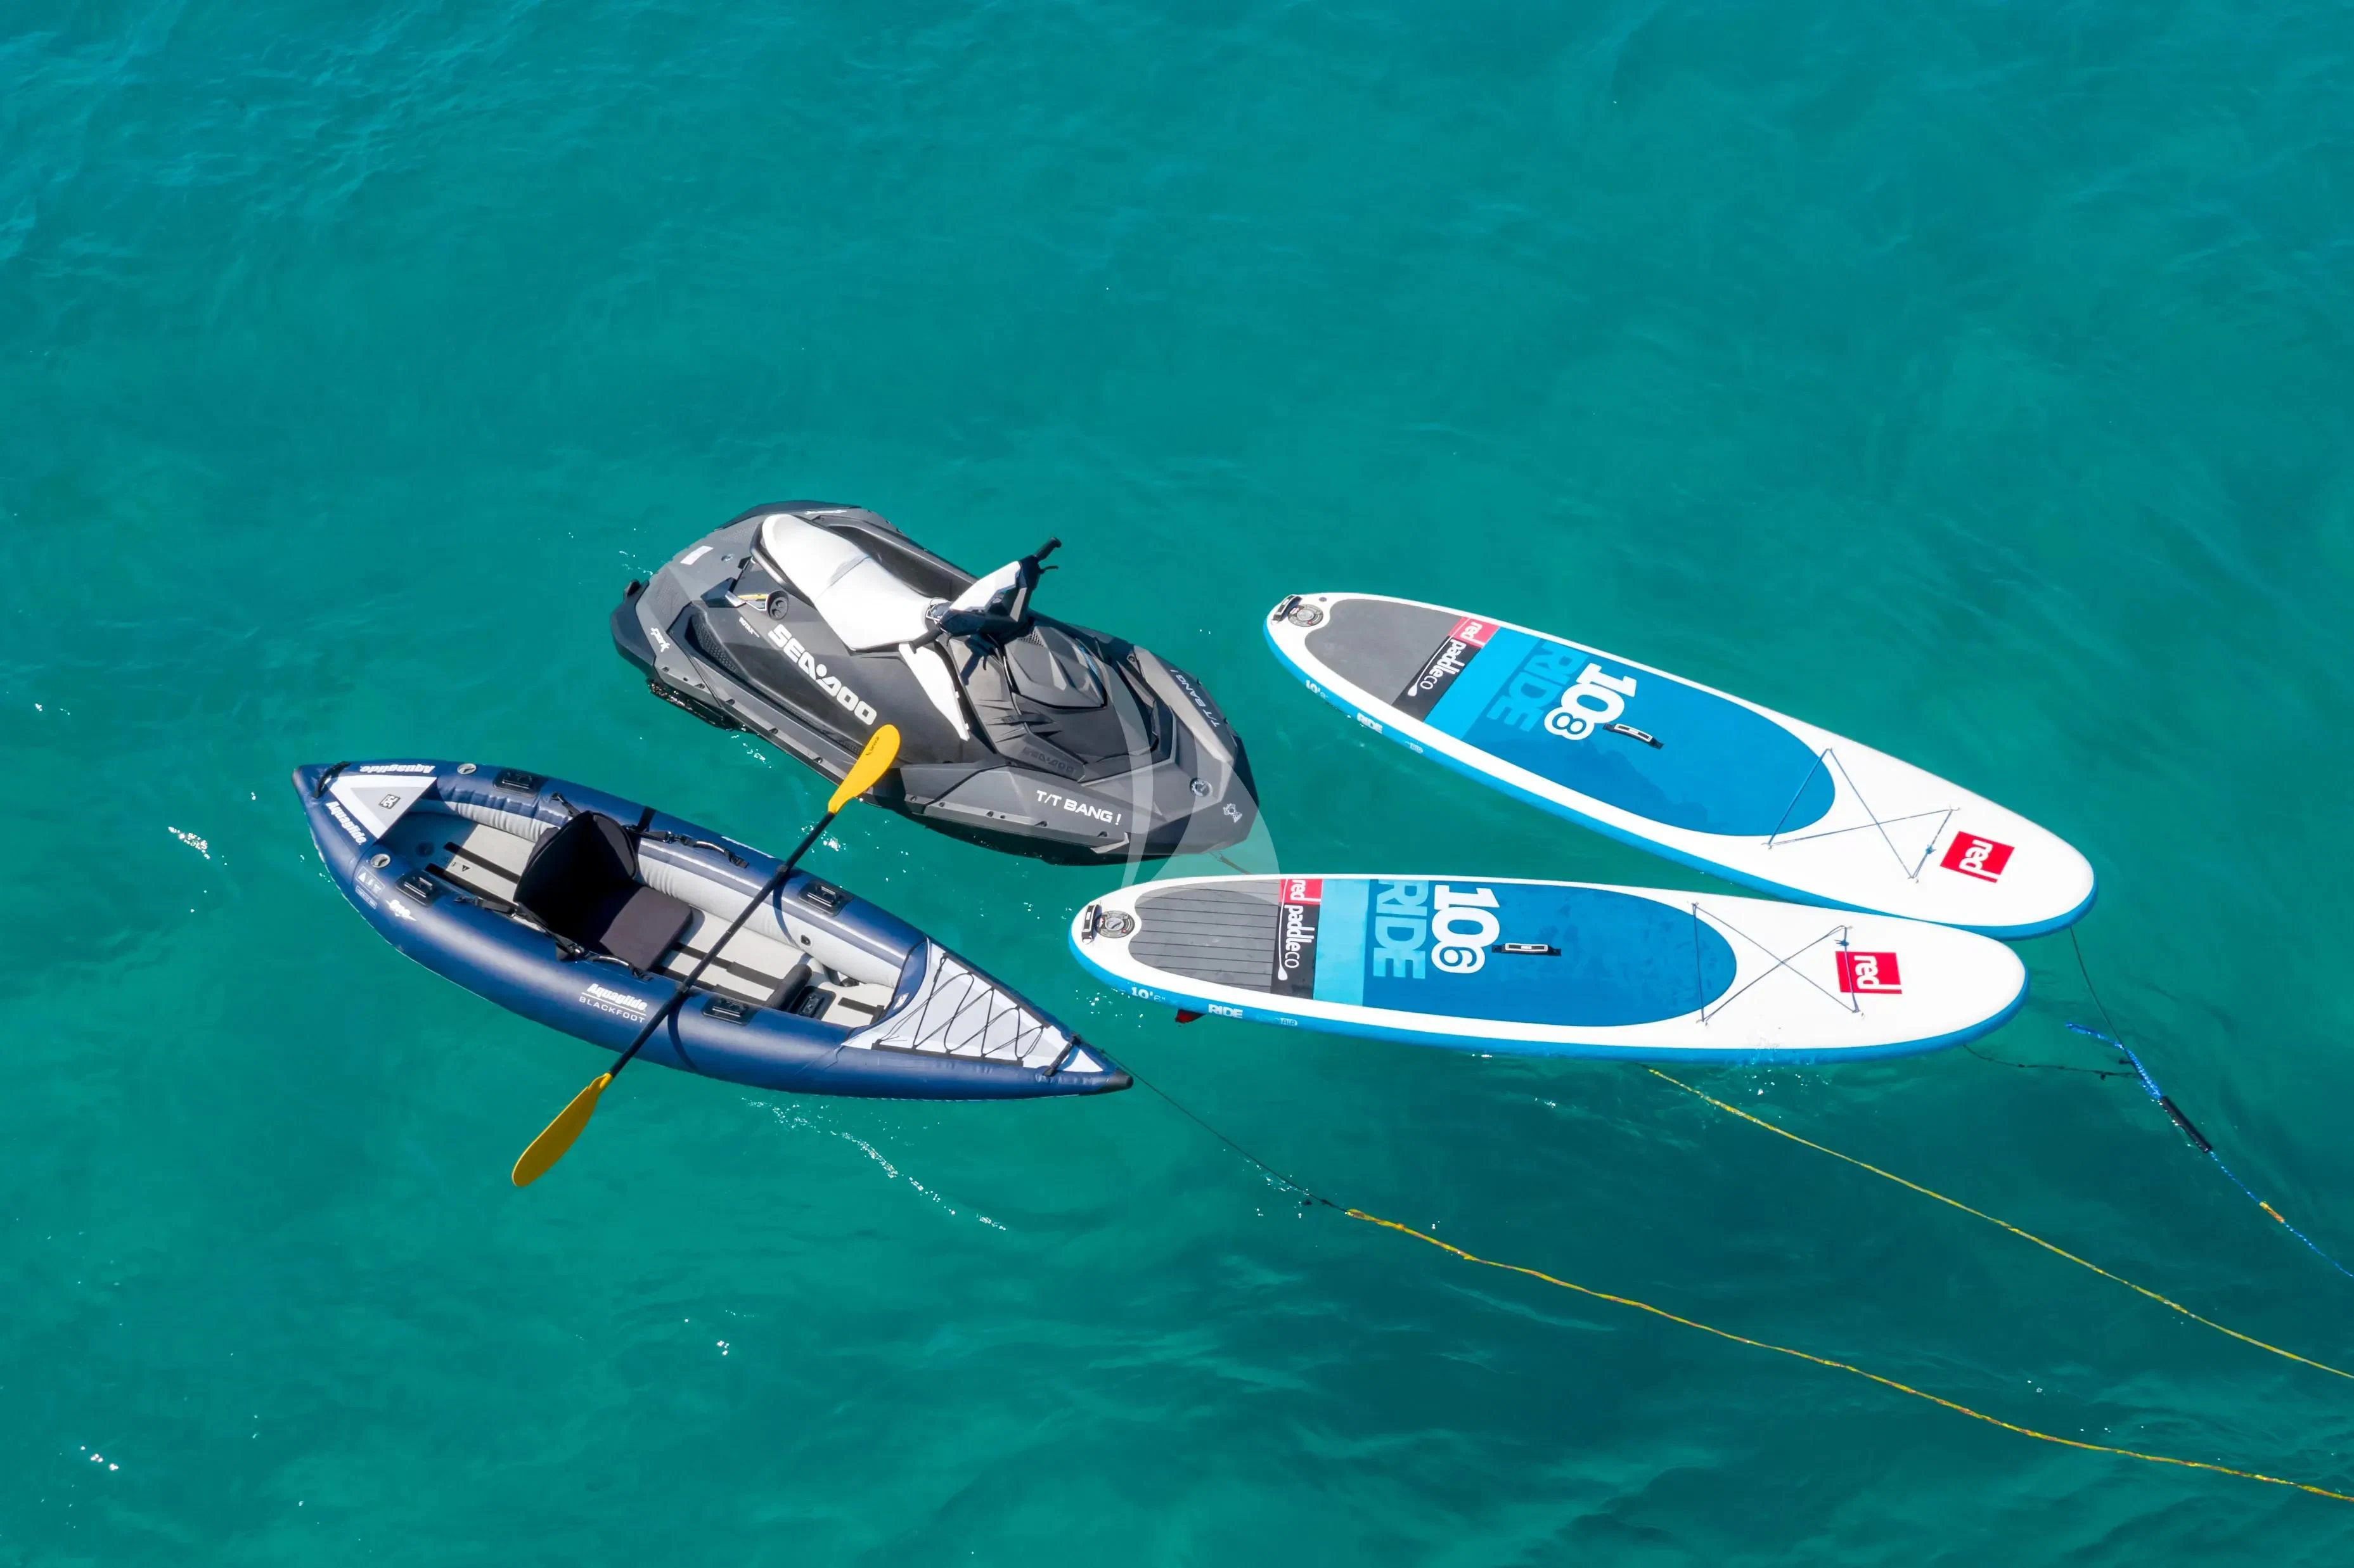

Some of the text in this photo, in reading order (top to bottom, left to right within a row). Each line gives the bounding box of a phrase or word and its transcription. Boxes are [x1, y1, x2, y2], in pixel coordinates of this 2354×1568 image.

[1460, 622, 1486, 646] red
[1176, 675, 1206, 707] BANG
[1486, 640, 1590, 732] RIDE
[1203, 709, 1219, 727] T/T
[359, 764, 435, 773] Aquaglide
[1036, 790, 1062, 806] T/T
[1064, 799, 1114, 823] BANG
[325, 801, 367, 845] Aquaglide
[1959, 839, 2000, 880] red
[1290, 879, 1321, 902] red
[1373, 880, 1429, 979] RIDE
[1854, 955, 1901, 989] red
[579, 996, 646, 1023] BLACKFOOT
[587, 983, 648, 1011] Aquaglide
[1208, 1004, 1243, 1019] RIDE
